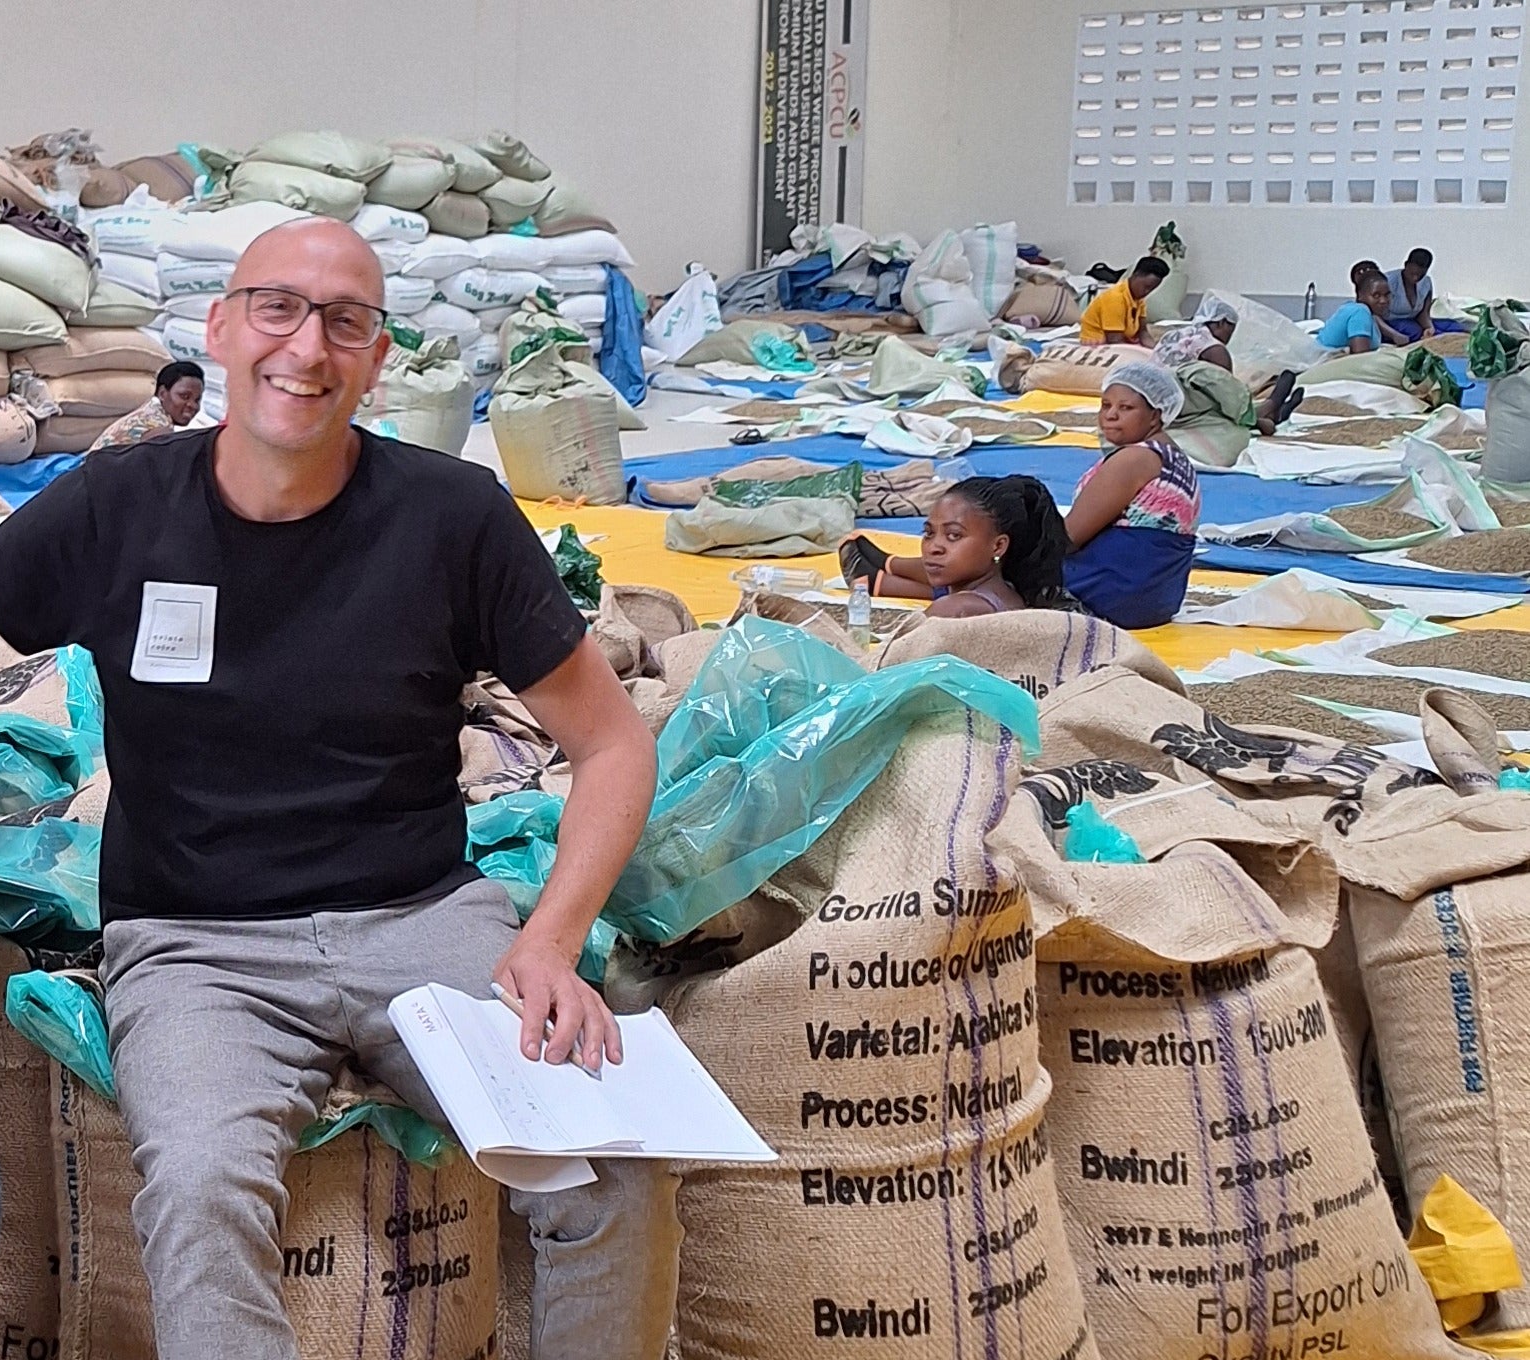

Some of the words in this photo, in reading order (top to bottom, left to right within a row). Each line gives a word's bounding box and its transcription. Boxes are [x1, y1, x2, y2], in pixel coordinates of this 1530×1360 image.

[814, 13, 824, 45] LTD
[765, 51, 775, 92] 2017
[789, 60, 800, 118] FUNDS
[812, 47, 823, 94] SILOS
[799, 88, 811, 140] USING
[829, 51, 847, 139] ACPCU
[763, 105, 773, 144] 2021
[774, 75, 788, 202] DEVELOPMENT
[788, 120, 799, 159] AND
[810, 96, 822, 145] WERE
[798, 144, 809, 180] FAIR
[786, 161, 797, 220] GRANT
[819, 890, 920, 923] Gorilla
[809, 951, 942, 990] Produce
[1059, 961, 1183, 997] Process:
[1191, 949, 1269, 996] Natural
[806, 1016, 941, 1060] Varietal:
[951, 997, 1022, 1052] Arabica
[800, 1090, 938, 1130] Process:
[948, 1065, 1023, 1120] Natural
[800, 1164, 965, 1207] Elevation:
[1080, 1143, 1189, 1187] Bwindi
[1148, 1264, 1216, 1289] weight
[1224, 1259, 1246, 1283] IN
[1196, 1297, 1258, 1337] For
[1271, 1270, 1366, 1328] Export
[1371, 1251, 1411, 1300] Only
[812, 1296, 932, 1339] Bwindi
